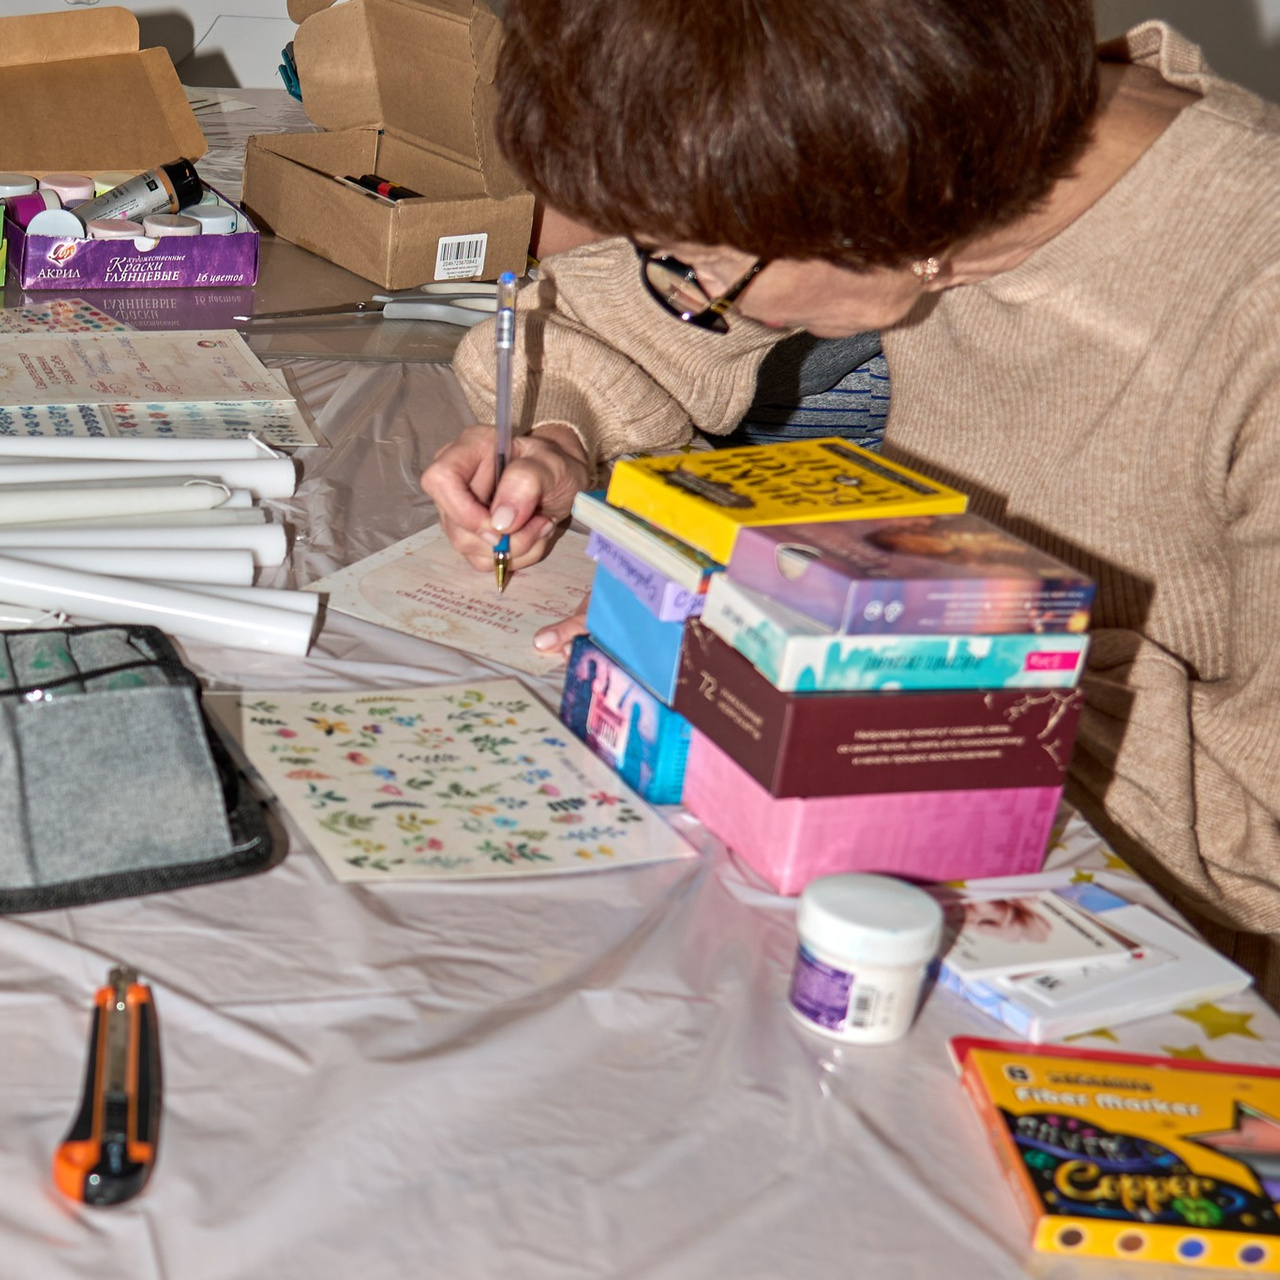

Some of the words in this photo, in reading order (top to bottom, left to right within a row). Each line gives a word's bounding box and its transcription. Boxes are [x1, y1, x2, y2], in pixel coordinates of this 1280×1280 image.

[107, 257, 163, 274] Краски
[126, 254, 186, 263] художественные
[38, 268, 81, 280] АКРИЛ
[104, 271, 180, 283] ГЛЯНЦЕВЫЕ
[196, 273, 208, 282] 16
[210, 273, 244, 282] цветов
[699, 670, 718, 701] 72
[1014, 1086, 1089, 1108] Fiber
[1054, 1158, 1216, 1214] Copper
